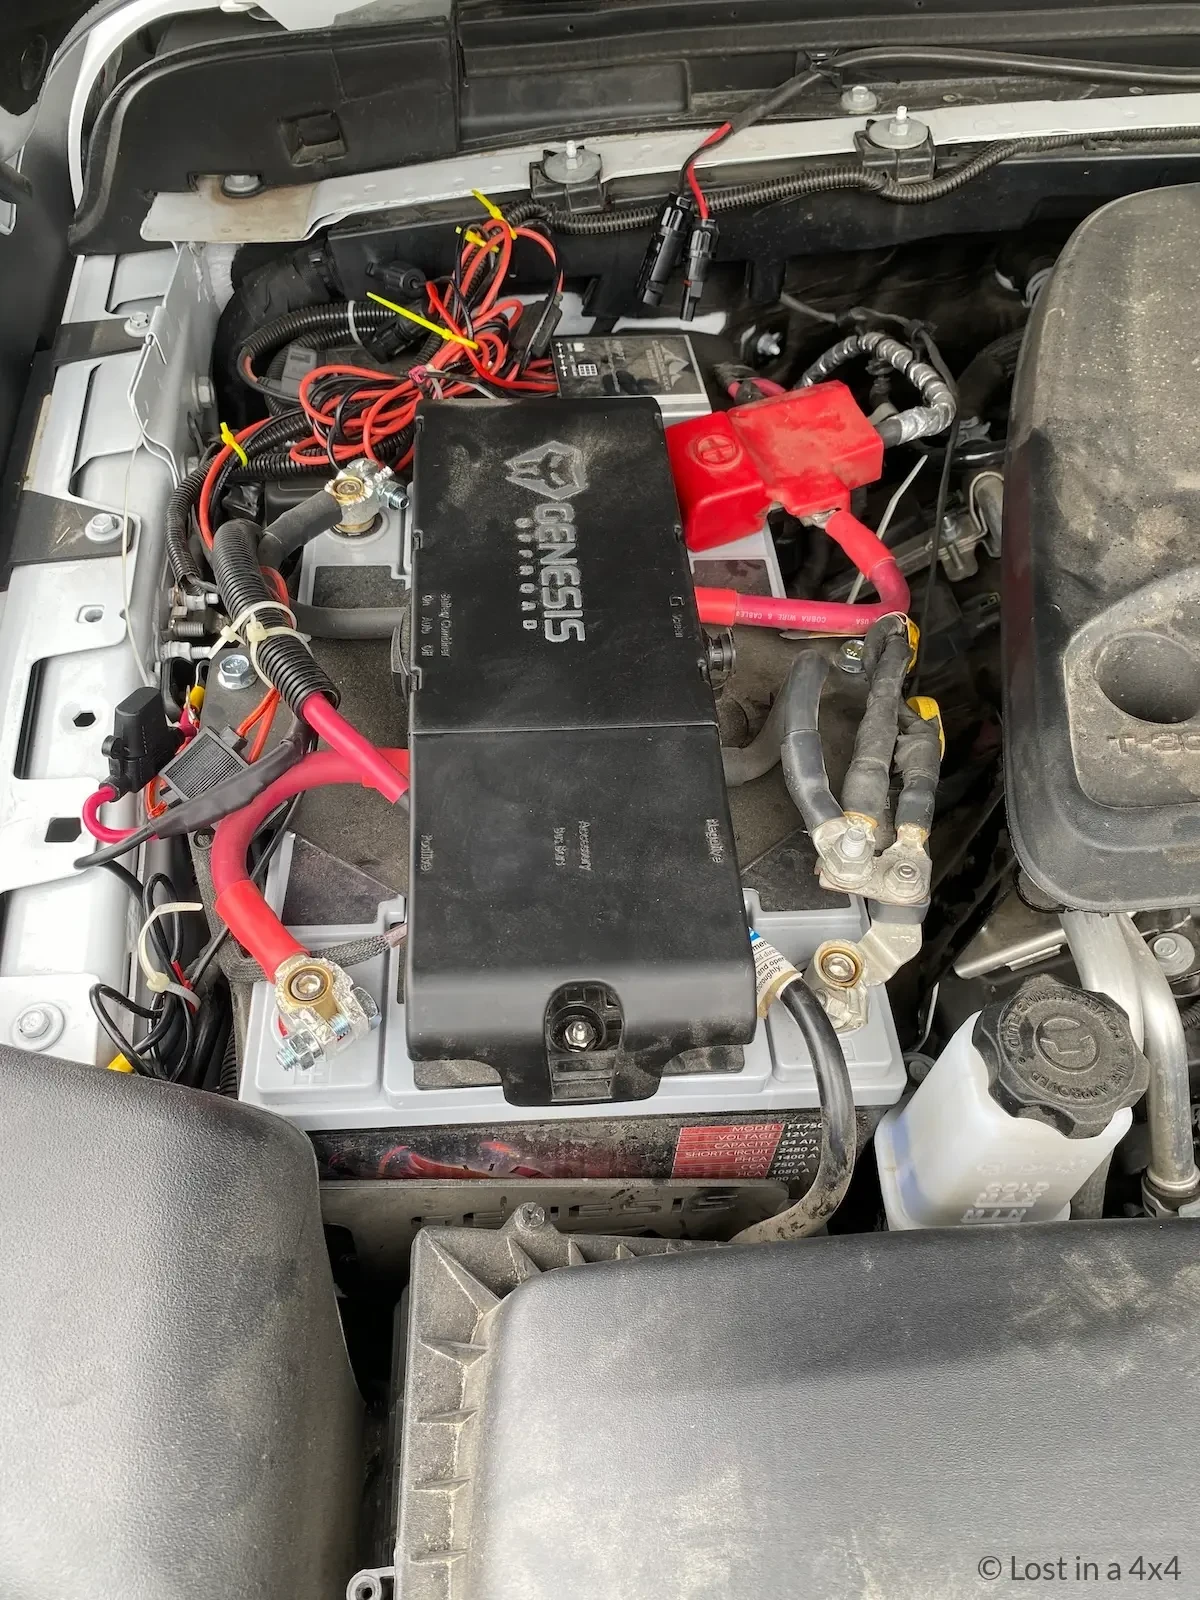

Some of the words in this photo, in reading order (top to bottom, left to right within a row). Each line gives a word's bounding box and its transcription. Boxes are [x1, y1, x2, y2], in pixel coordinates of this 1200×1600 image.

[514, 517, 538, 630] OFFROAD
[534, 502, 586, 643] GENESIS
[777, 613, 796, 621] WIRE
[801, 615, 826, 624] COBRA
[578, 820, 592, 871] Accessory
[705, 818, 724, 863] Negative
[420, 834, 434, 871] Positive
[757, 963, 769, 977] and
[731, 1124, 775, 1132] MODEL
[718, 1132, 775, 1140] VOLTAGE
[714, 1140, 773, 1149] CAPACITY
[685, 1150, 728, 1158] SHORT
[729, 1148, 769, 1156] CIRCUIT
[778, 1146, 808, 1154] 2480
[985, 1181, 1050, 1192] COLD
[962, 1208, 1026, 1220] MIN
